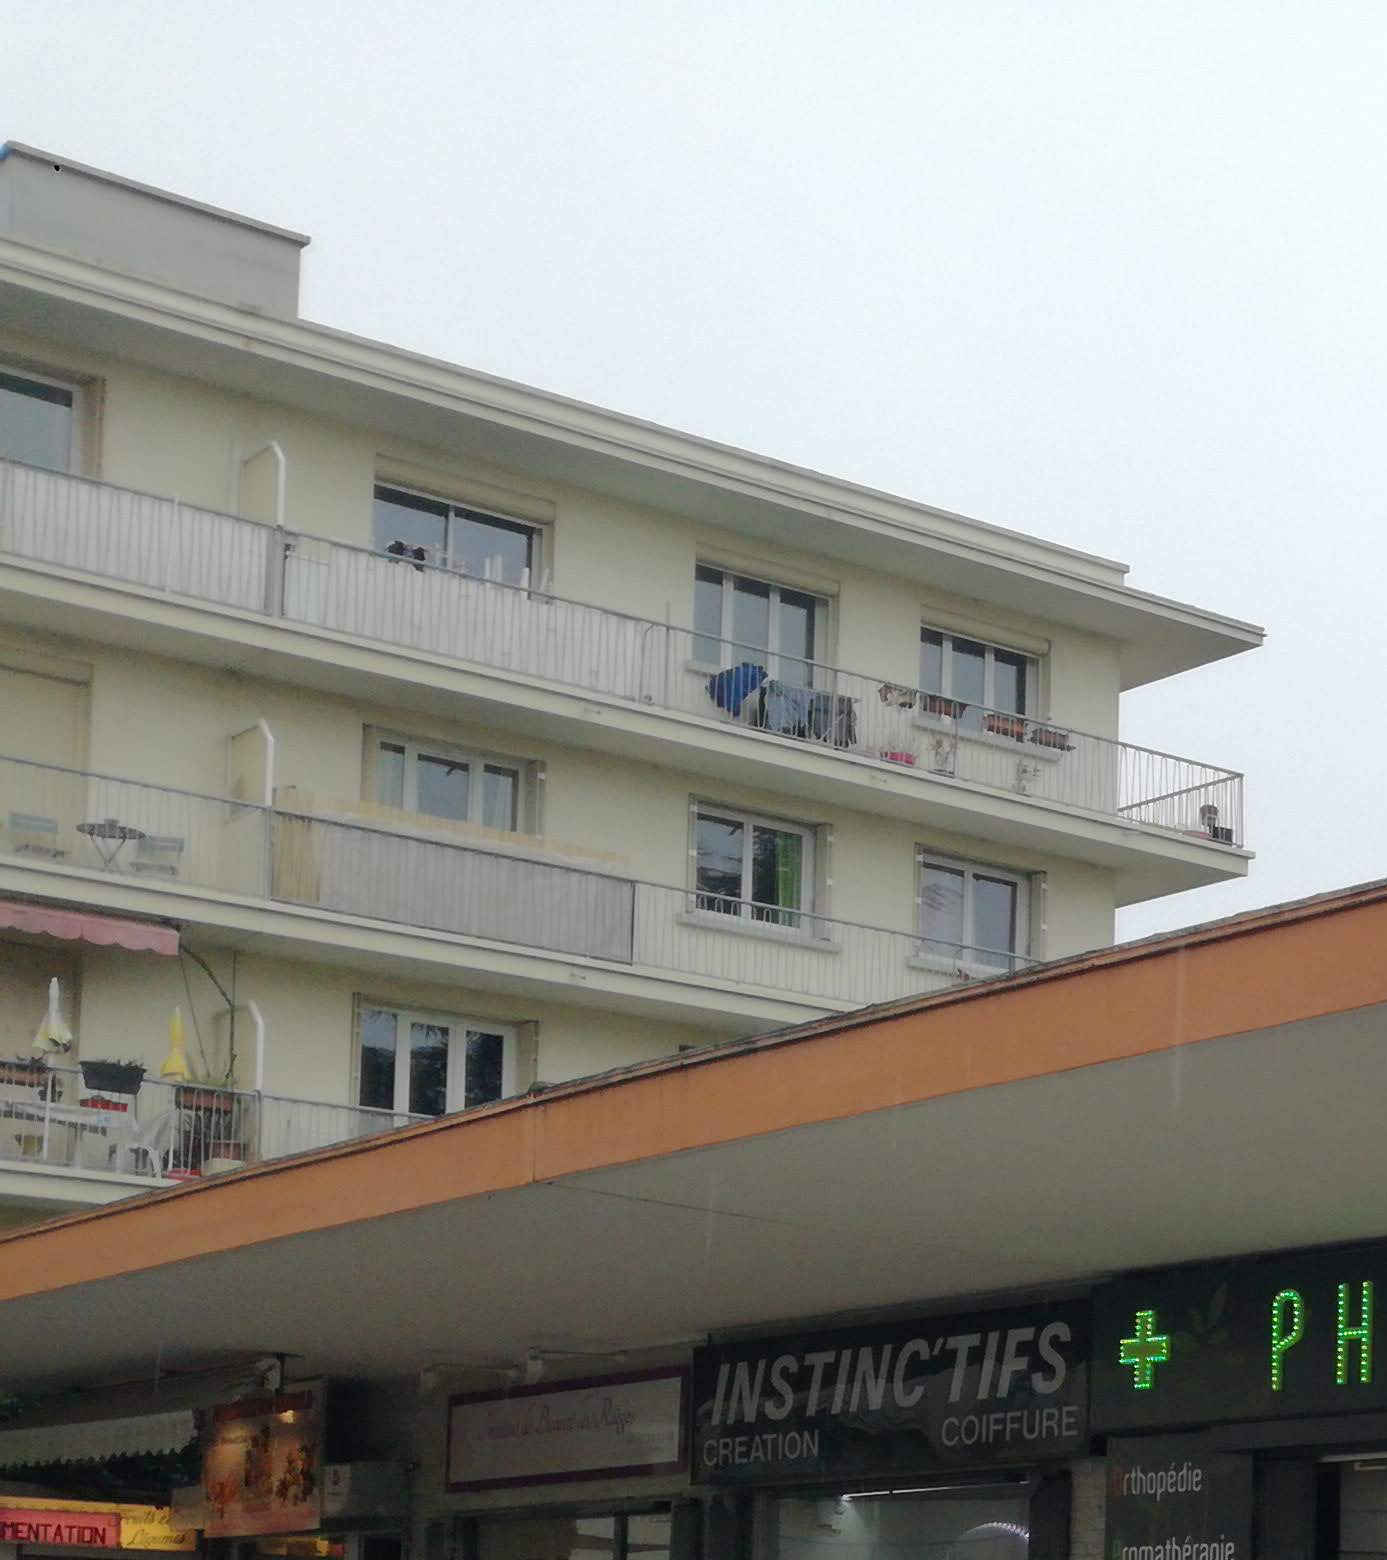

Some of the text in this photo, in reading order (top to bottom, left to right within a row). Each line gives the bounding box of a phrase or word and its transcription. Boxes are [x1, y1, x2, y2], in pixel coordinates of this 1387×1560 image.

[711, 1321, 1071, 1426] INSTINC'TIFS
[941, 1405, 1079, 1447] COIFFURE
[703, 1429, 820, 1467] CREATION
[1112, 1462, 1202, 1502] Orthopédie
[0, 1520, 106, 1545] MENTATION
